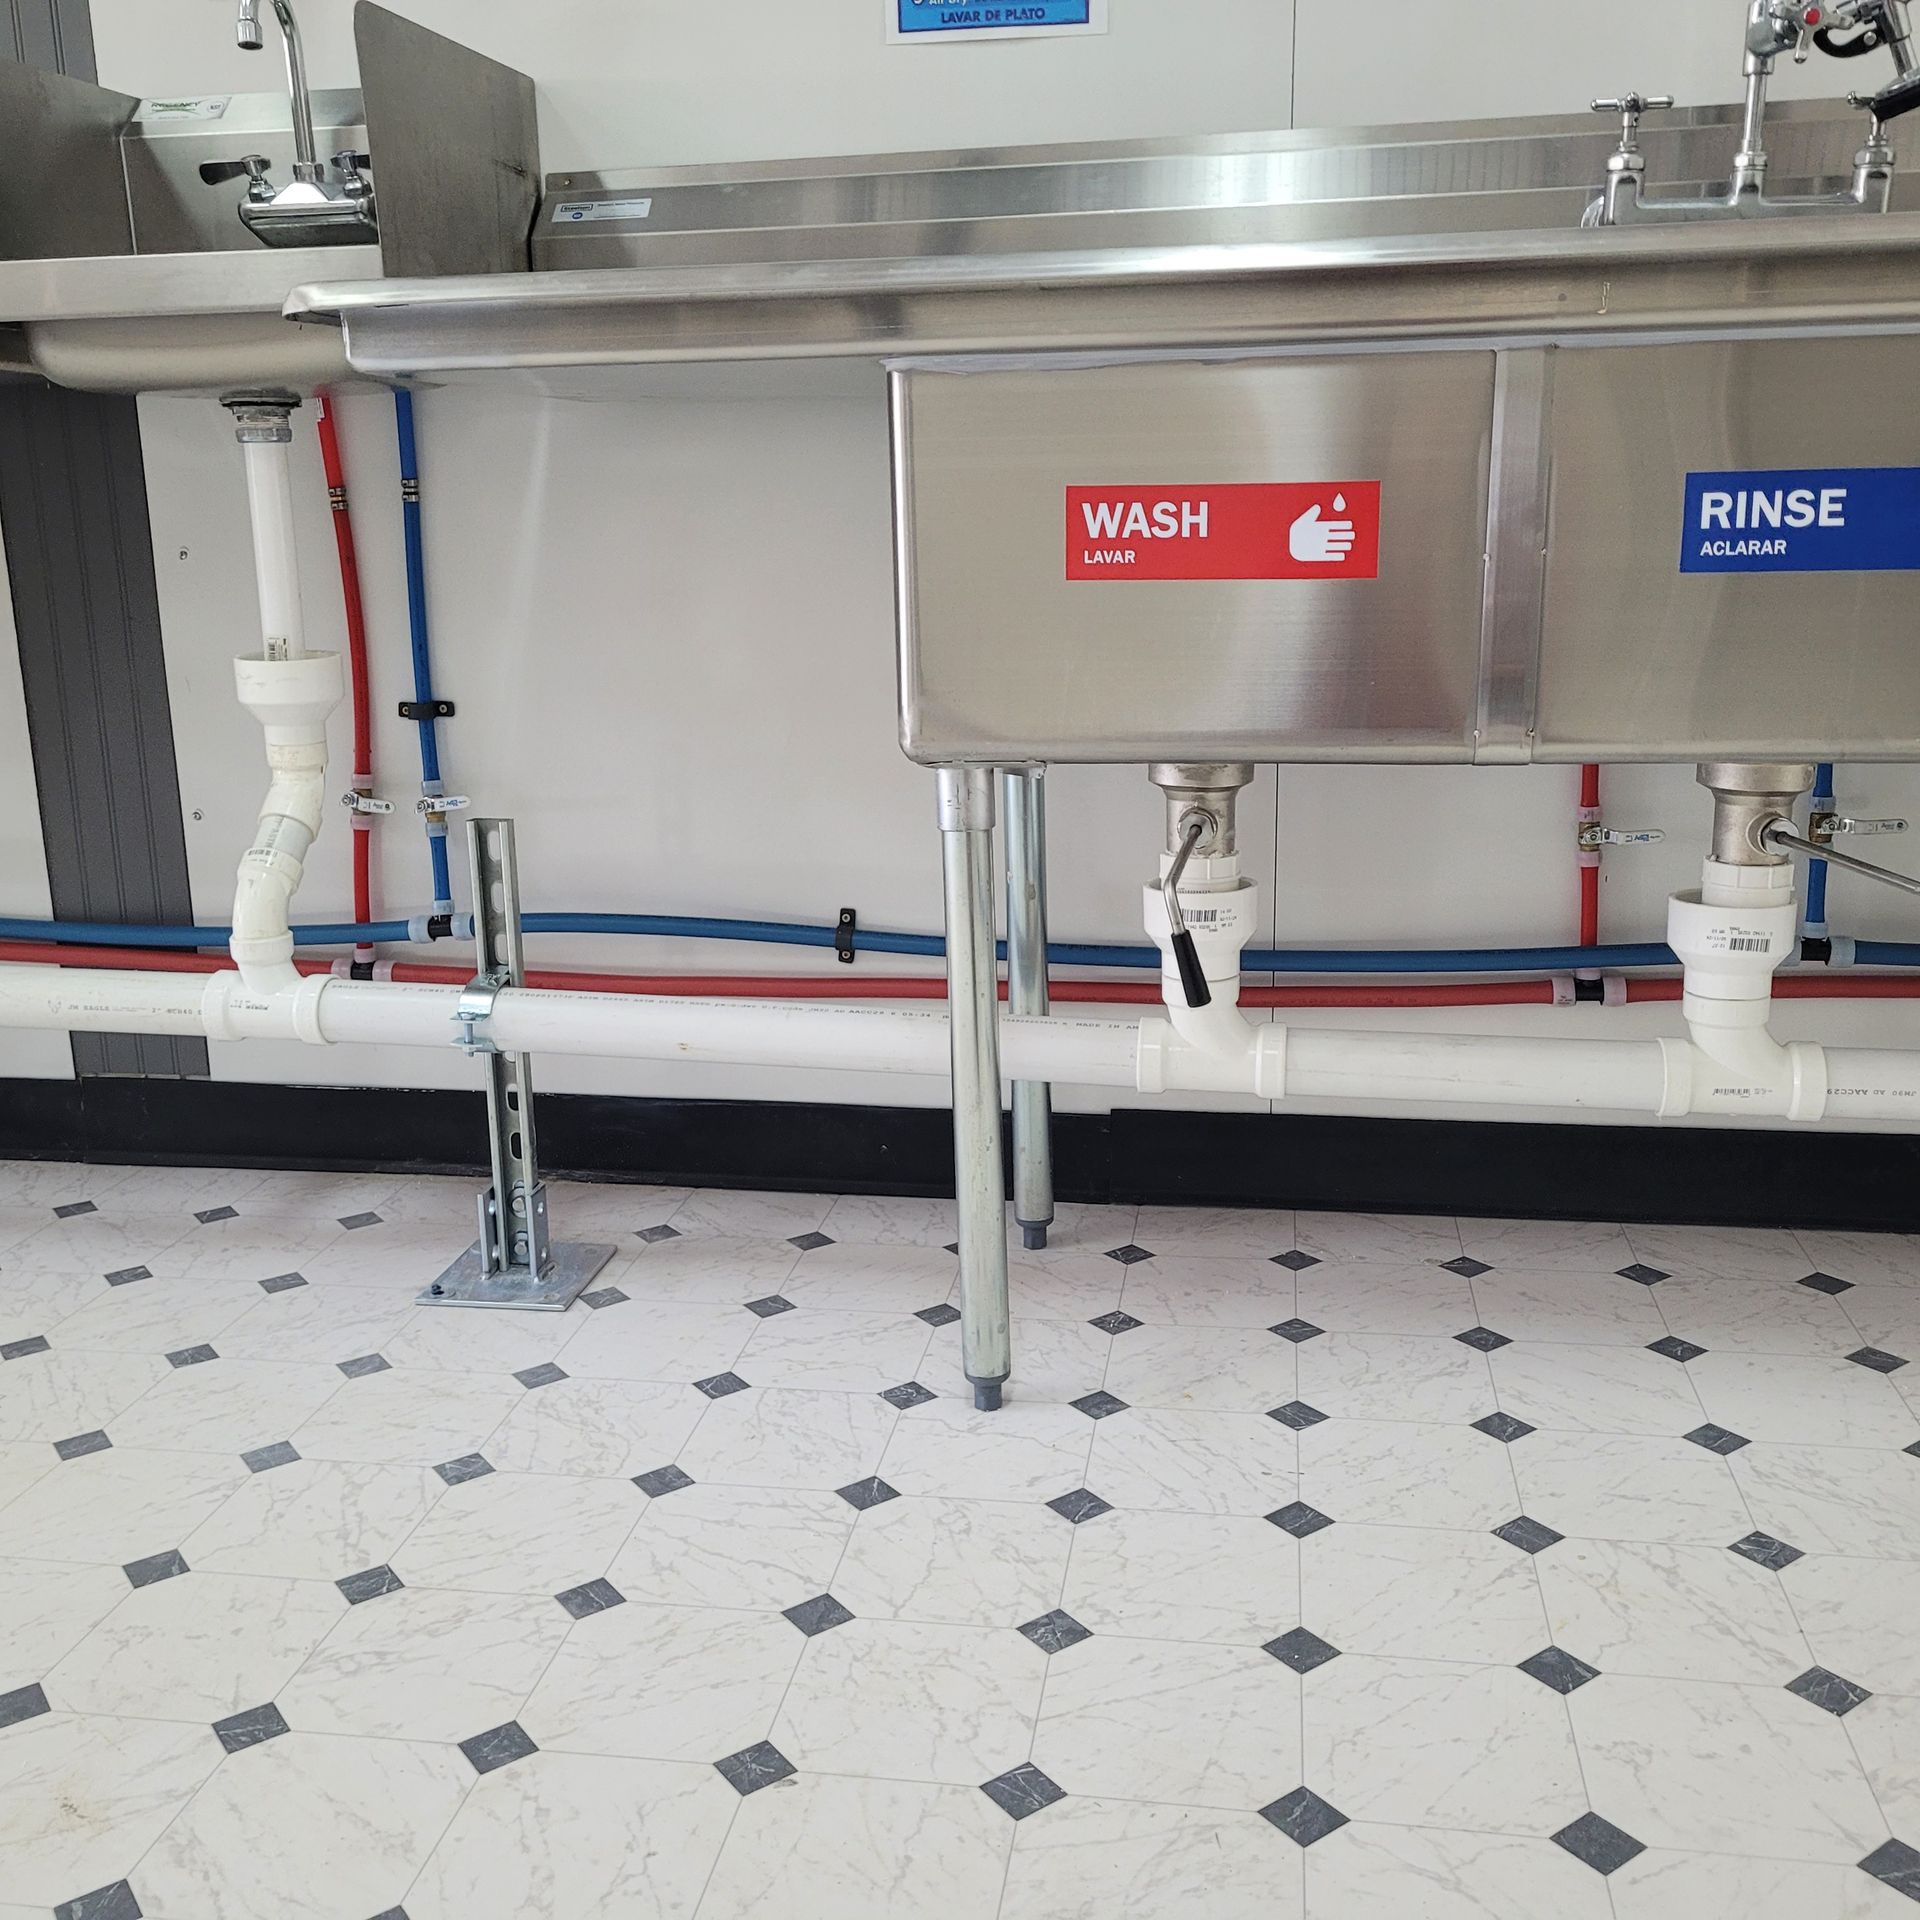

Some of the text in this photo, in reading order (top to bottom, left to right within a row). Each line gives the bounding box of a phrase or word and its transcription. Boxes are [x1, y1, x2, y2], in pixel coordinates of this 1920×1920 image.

[941, 8, 1046, 24] LAVAR DE PLATO
[1700, 488, 1848, 530] RINSE
[1082, 500, 1209, 539] WASH
[1700, 539, 1787, 556] ACLARAR
[1084, 550, 1136, 564] LAVAR
